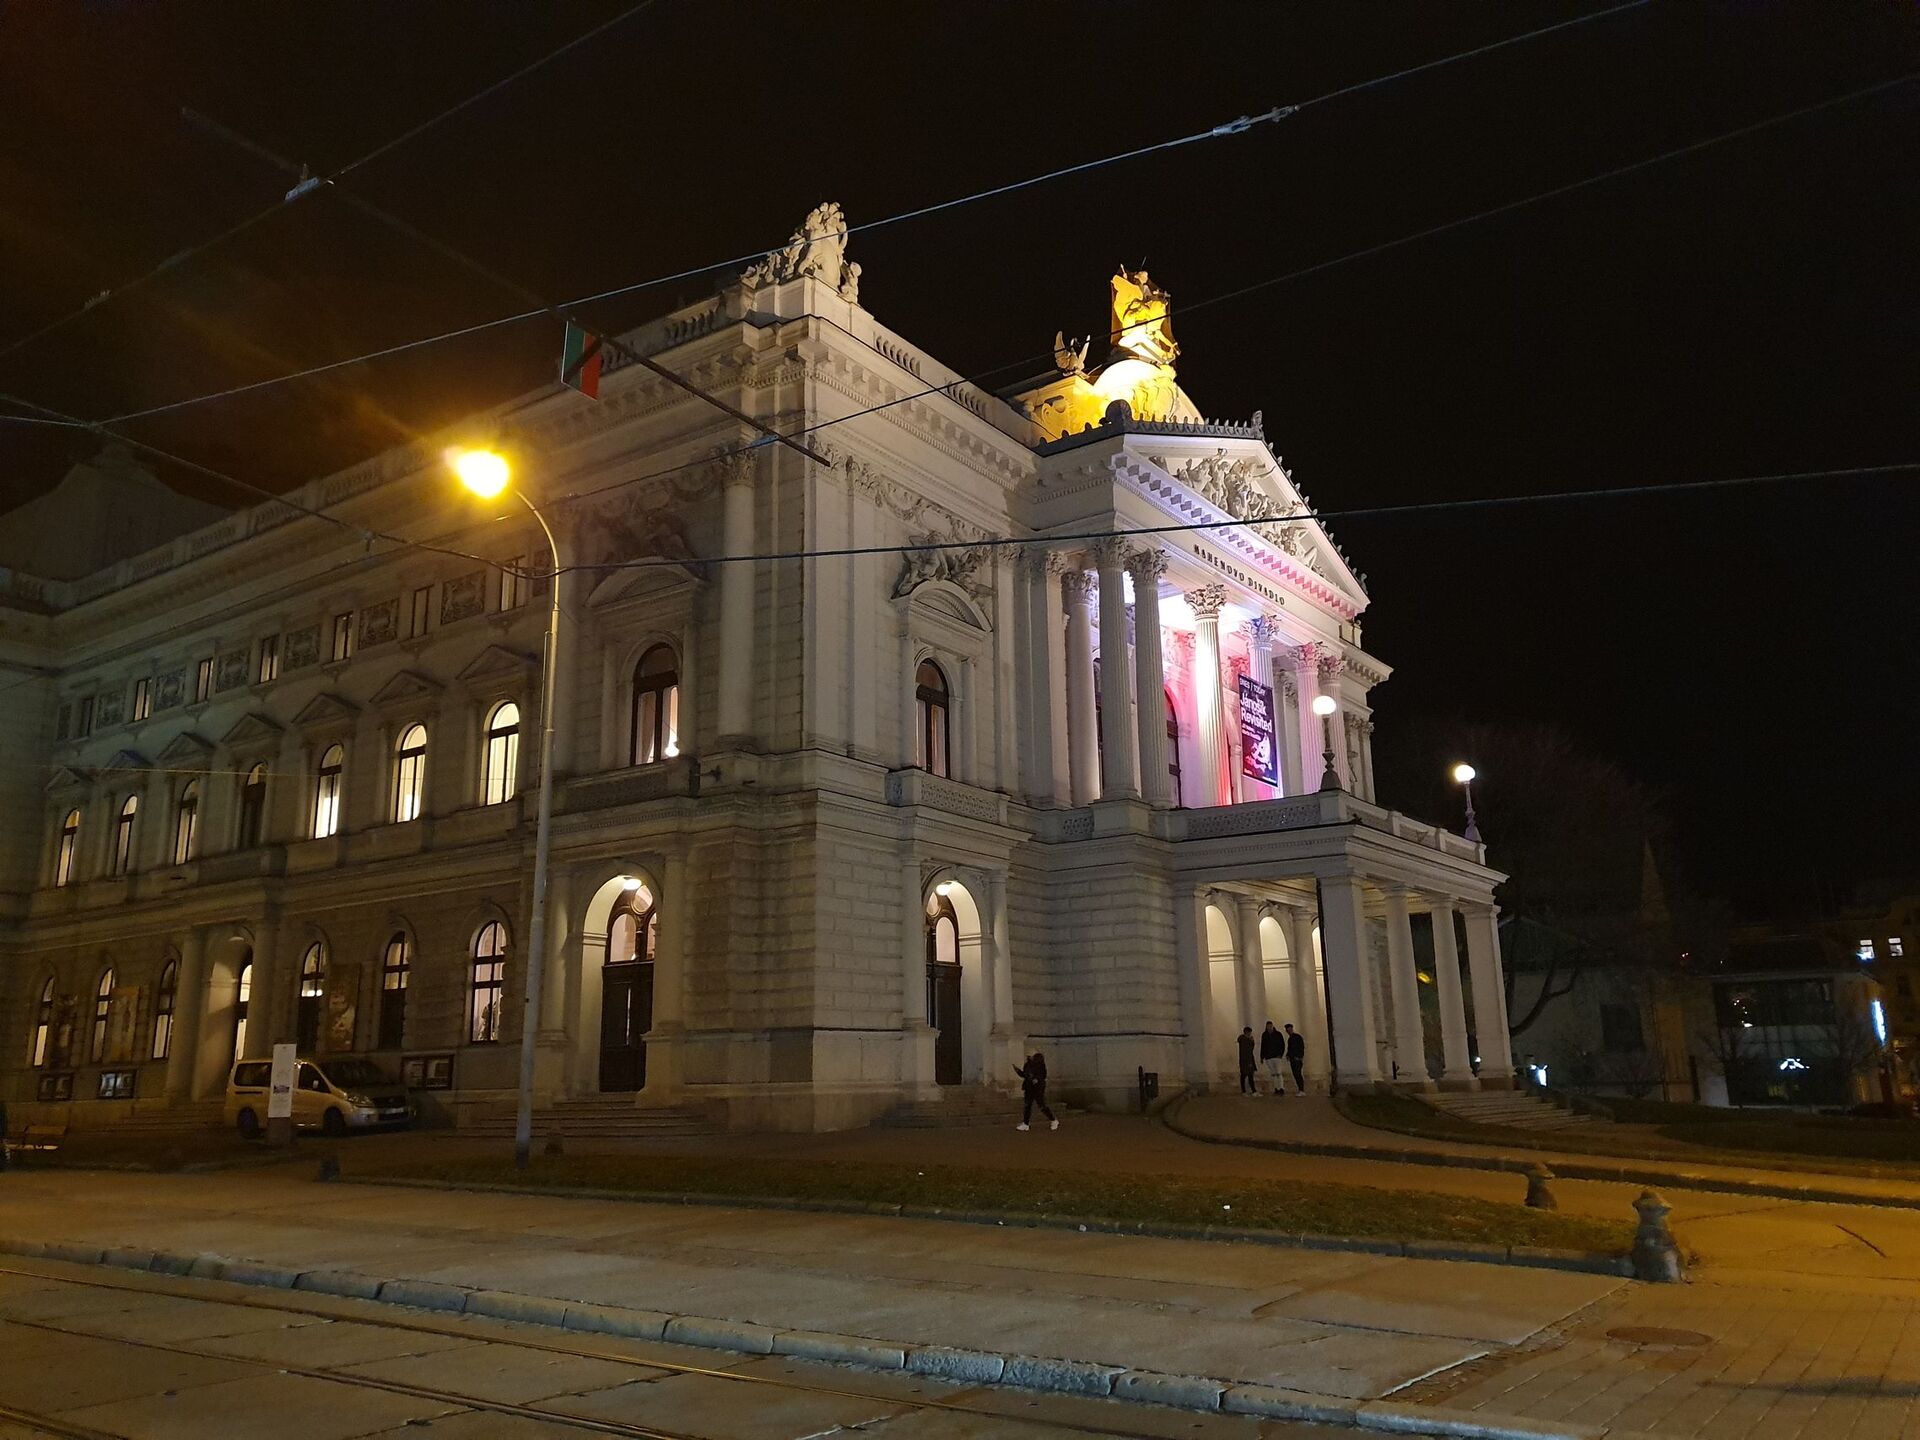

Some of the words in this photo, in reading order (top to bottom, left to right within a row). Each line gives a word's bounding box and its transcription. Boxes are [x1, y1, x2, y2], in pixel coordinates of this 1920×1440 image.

[1194, 544, 1245, 582] MAHENOVO
[1247, 577, 1285, 605] DIVADLO
[1241, 707, 1272, 733] Revisited
